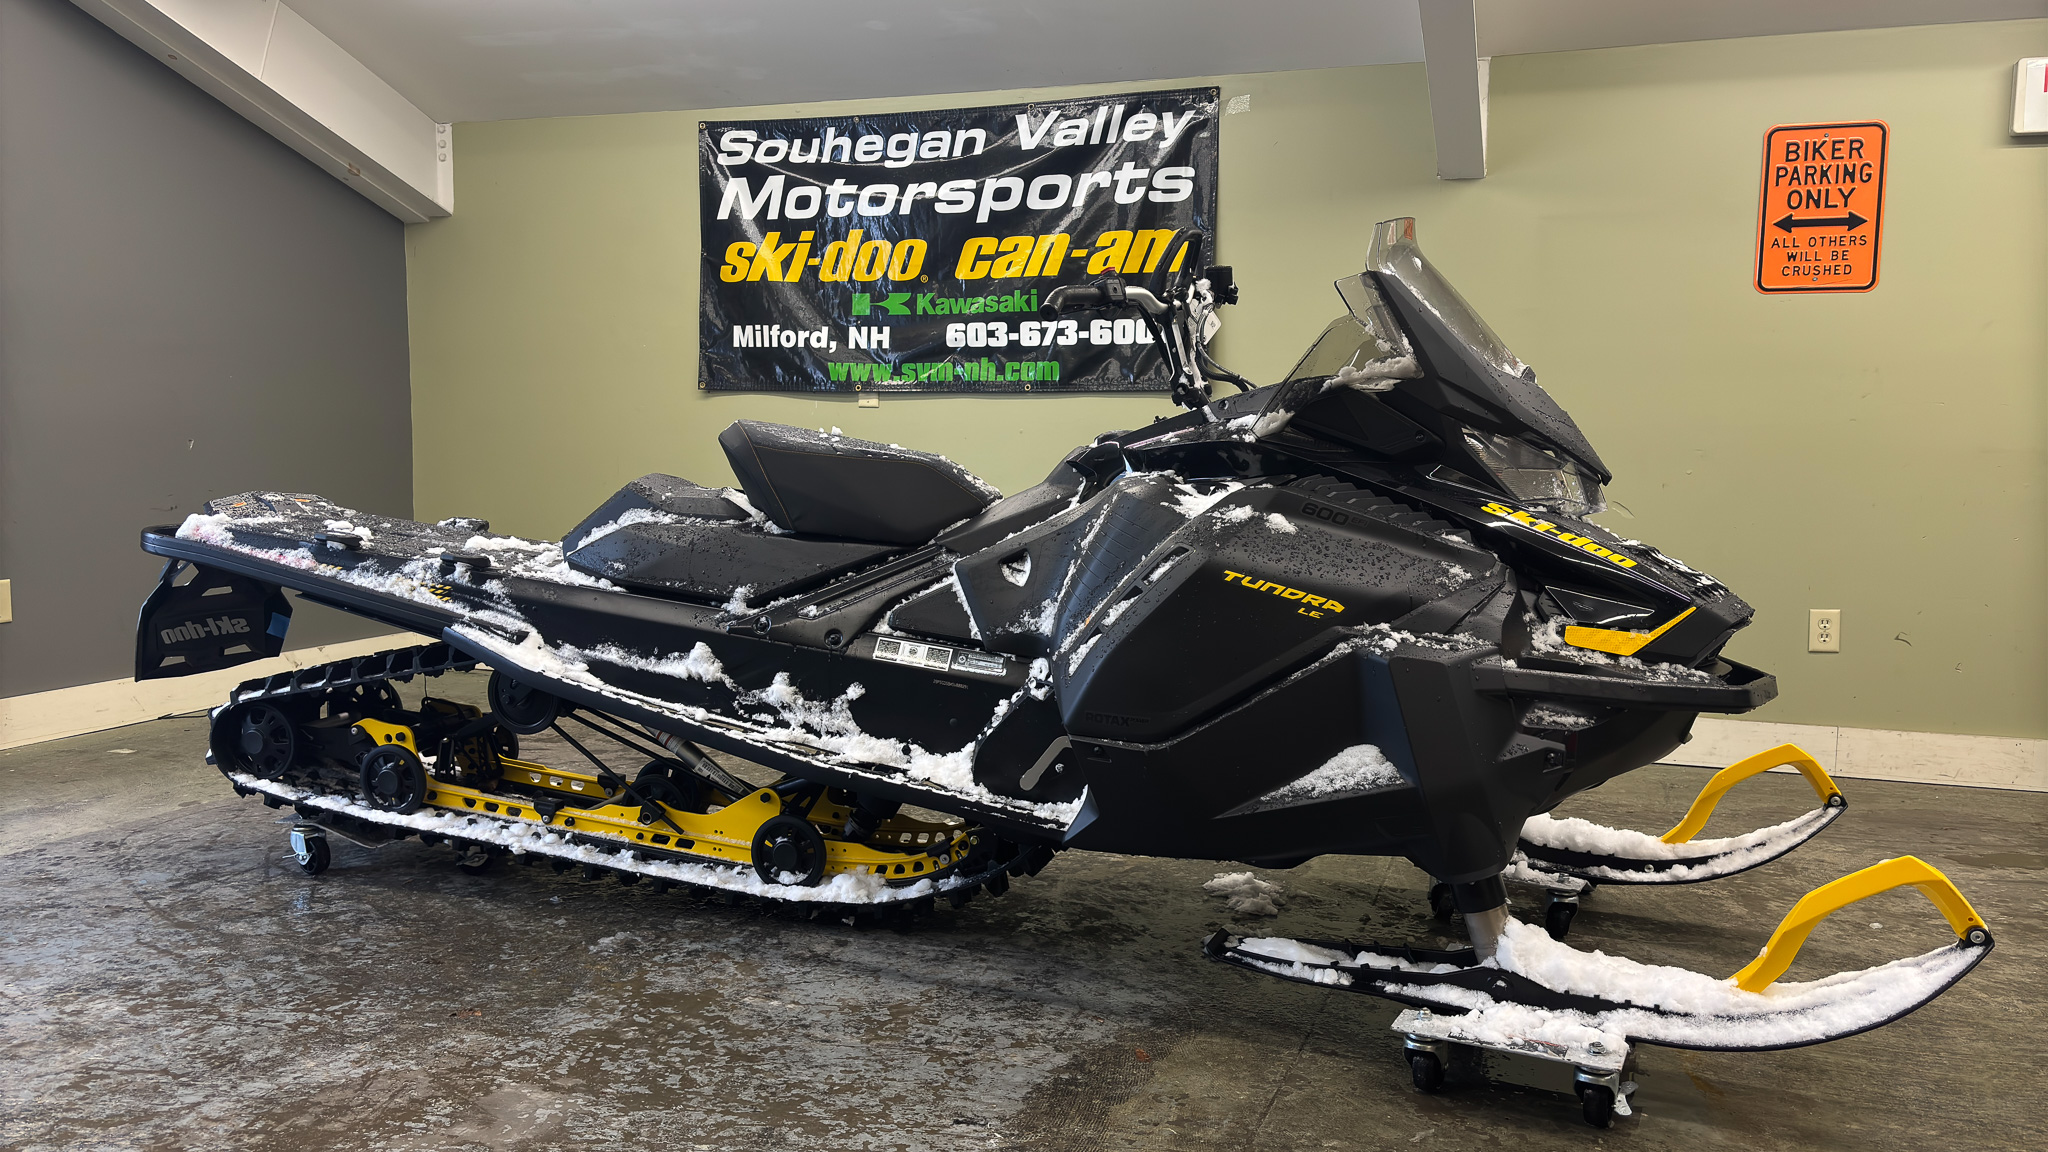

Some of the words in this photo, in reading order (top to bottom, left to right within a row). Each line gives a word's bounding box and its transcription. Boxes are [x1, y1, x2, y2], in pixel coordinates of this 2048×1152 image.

[716, 126, 987, 169] Souhegan
[1014, 105, 1197, 151] Valley
[1785, 138, 1864, 162] BIKER
[1775, 162, 1873, 187] PARKING
[716, 161, 1196, 224] Motorsports
[1787, 187, 1856, 210] ONLY
[955, 227, 1189, 281] can-am
[1771, 237, 1800, 249] ALL
[1808, 235, 1868, 248] OTHERS
[719, 229, 928, 283] ski-doo
[1787, 251, 1822, 262] WILL
[1831, 250, 1850, 261] BE
[1781, 264, 1852, 276] CRUSHED
[916, 289, 1038, 316] Kawasaki
[733, 325, 837, 353] Milford,
[848, 326, 890, 349] NH
[946, 319, 1168, 348] 603-673-600
[828, 357, 1060, 383] www.svm-nh.com
[1301, 502, 1349, 526] 600
[1223, 569, 1346, 613] TUNDRA
[1297, 607, 1324, 619] LE
[1085, 712, 1130, 727] ROTAX
